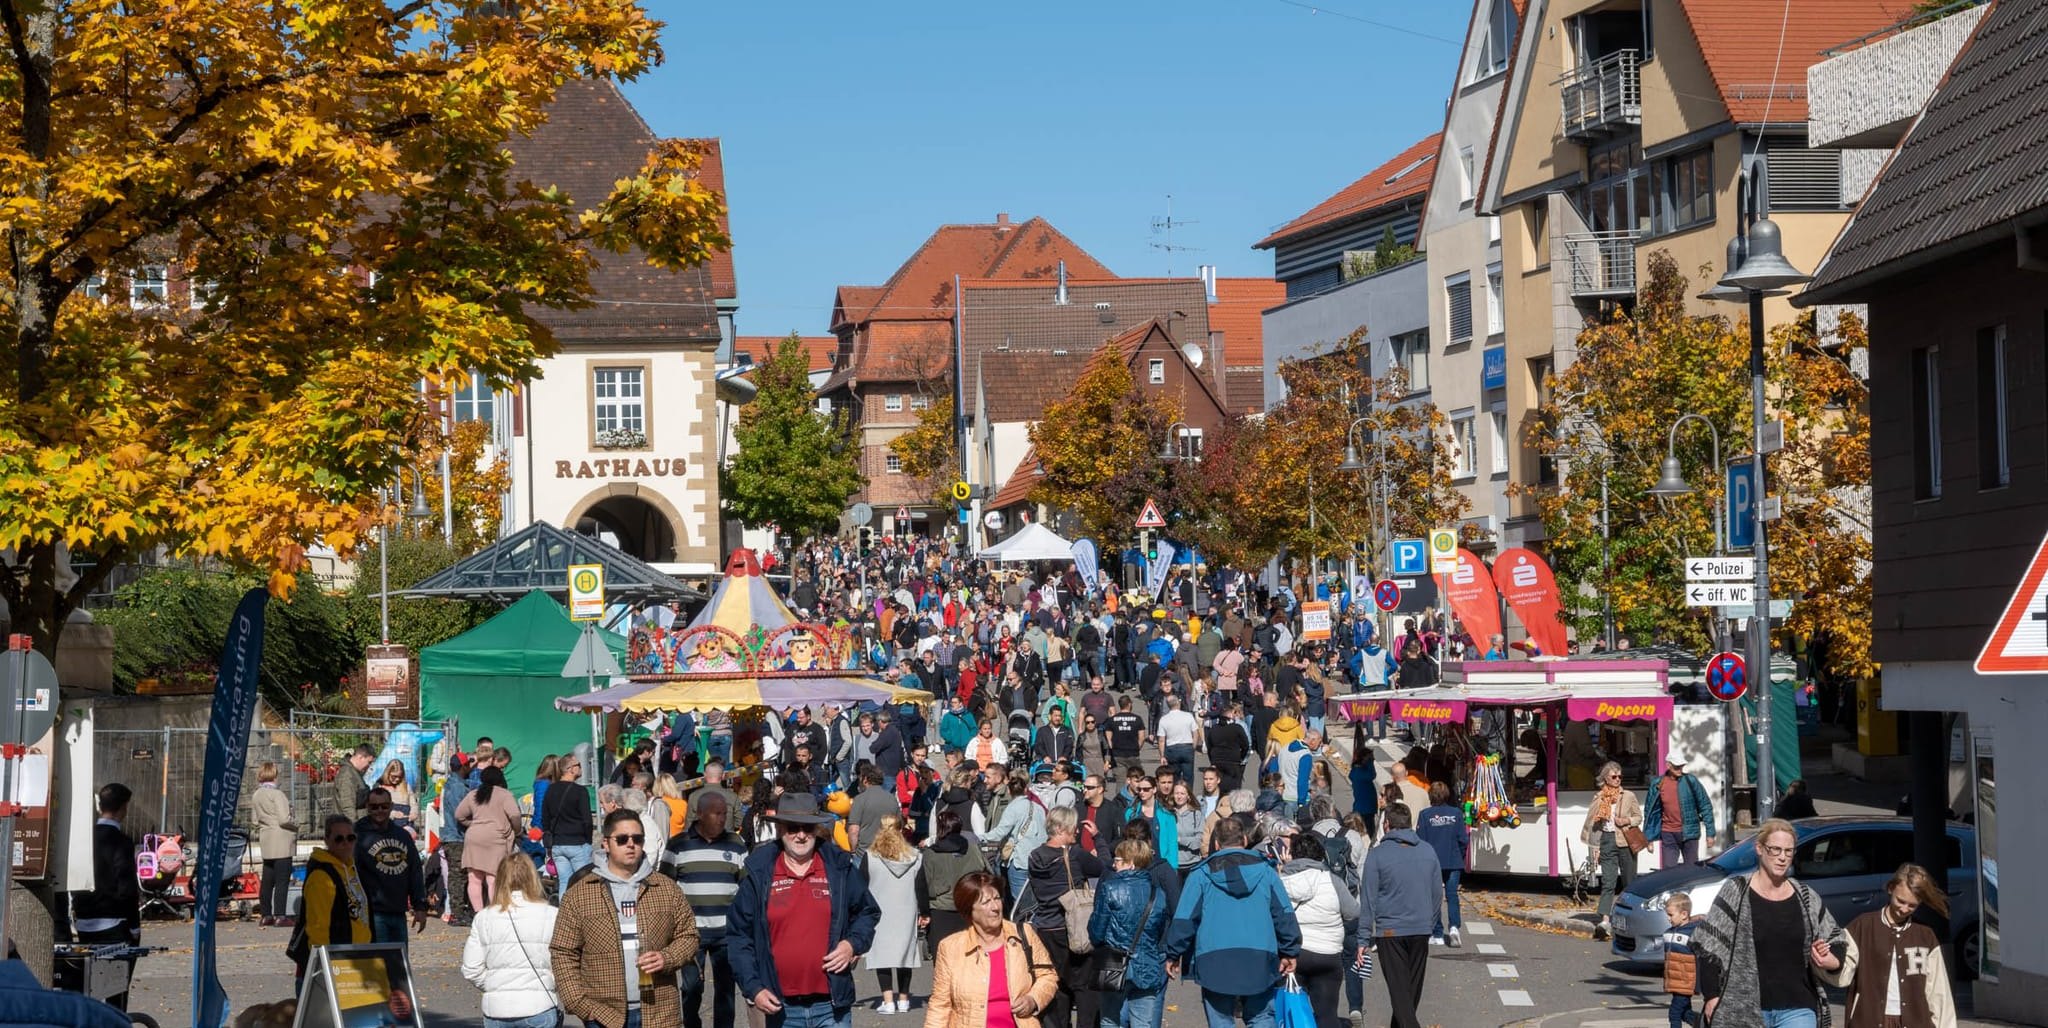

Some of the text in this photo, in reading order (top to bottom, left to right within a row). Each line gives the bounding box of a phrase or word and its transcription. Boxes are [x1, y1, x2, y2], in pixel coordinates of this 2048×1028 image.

[555, 458, 687, 478] RATHAUS
[1735, 474, 1749, 537] P
[1400, 544, 1417, 569] P
[1707, 562, 1744, 575] Polizei
[314, 573, 358, 581] Primave
[581, 575, 592, 589] H
[1708, 588, 1747, 601] öff. WC
[1401, 703, 1451, 719] Erdnüsse
[1596, 702, 1656, 719] Popcorn
[1904, 946, 1930, 976] H
